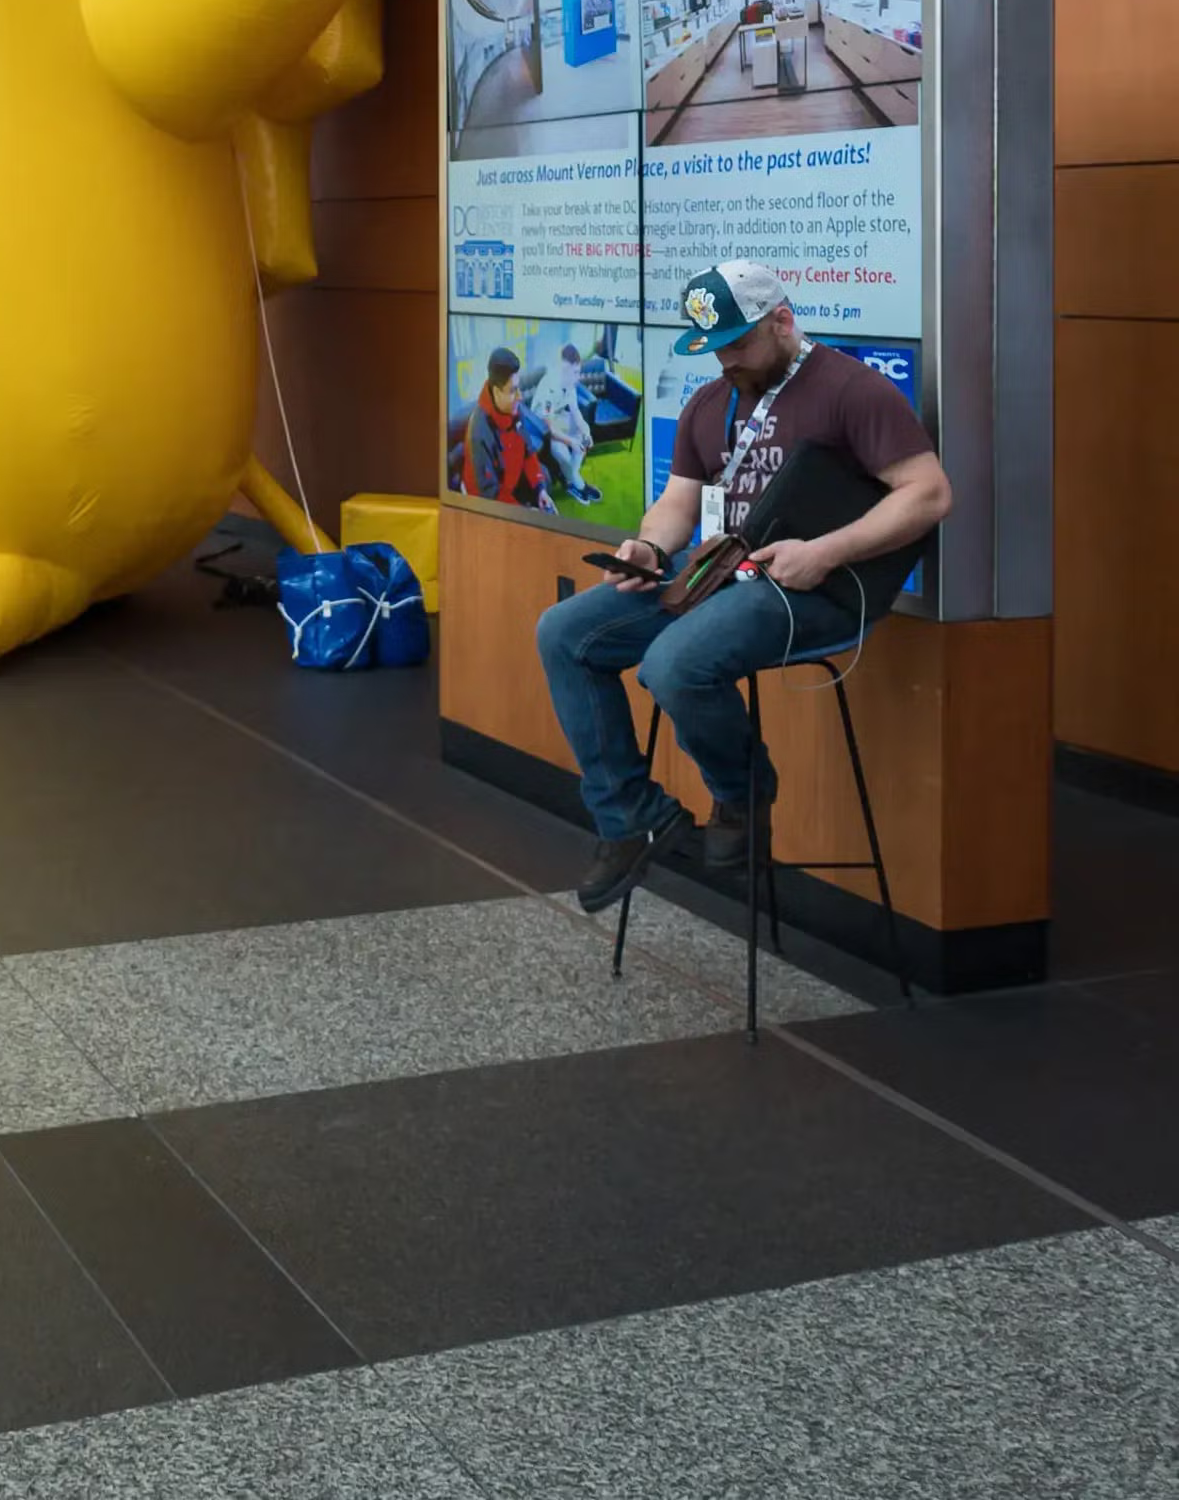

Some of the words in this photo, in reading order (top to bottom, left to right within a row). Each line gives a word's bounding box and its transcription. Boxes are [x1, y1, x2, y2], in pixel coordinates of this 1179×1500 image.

[476, 170, 497, 187] Just
[500, 168, 533, 185] across
[536, 164, 573, 182] Mount
[577, 161, 620, 180] Vernon
[624, 157, 667, 180] Place,
[672, 160, 680, 176] a
[684, 153, 713, 175] visit
[718, 153, 733, 173] to
[738, 150, 763, 172] the
[767, 148, 802, 176] past
[807, 141, 871, 168] awaits!
[564, 200, 591, 216] break
[593, 202, 603, 215] at
[605, 200, 621, 215] the
[623, 199, 638, 214] DC
[644, 198, 680, 217] History
[684, 198, 725, 214] Center,
[727, 199, 742, 212] on
[745, 194, 766, 211] the
[769, 192, 814, 211] second
[817, 190, 850, 208] floor
[853, 188, 868, 208] of
[871, 188, 895, 207] the
[548, 222, 587, 236] restored
[589, 220, 624, 236] historic
[723, 220, 734, 235] In
[738, 217, 787, 235] addition
[790, 219, 805, 234] to
[807, 219, 823, 234] an
[826, 215, 867, 238] Apple
[869, 215, 911, 235] store,
[565, 243, 583, 257] THE
[585, 243, 603, 257] BIG
[680, 241, 718, 258] exhibit
[720, 240, 734, 258] of
[736, 241, 800, 260] panoramic
[803, 241, 851, 264] images
[854, 241, 869, 259] of
[543, 263, 577, 281] century
[674, 264, 692, 280] the
[805, 266, 851, 283] Center
[854, 266, 897, 284] Store.
[574, 294, 606, 310] Tuesday
[660, 298, 671, 311] 10
[820, 303, 831, 317] to
[833, 303, 841, 318] 5
[843, 306, 862, 320] pm
